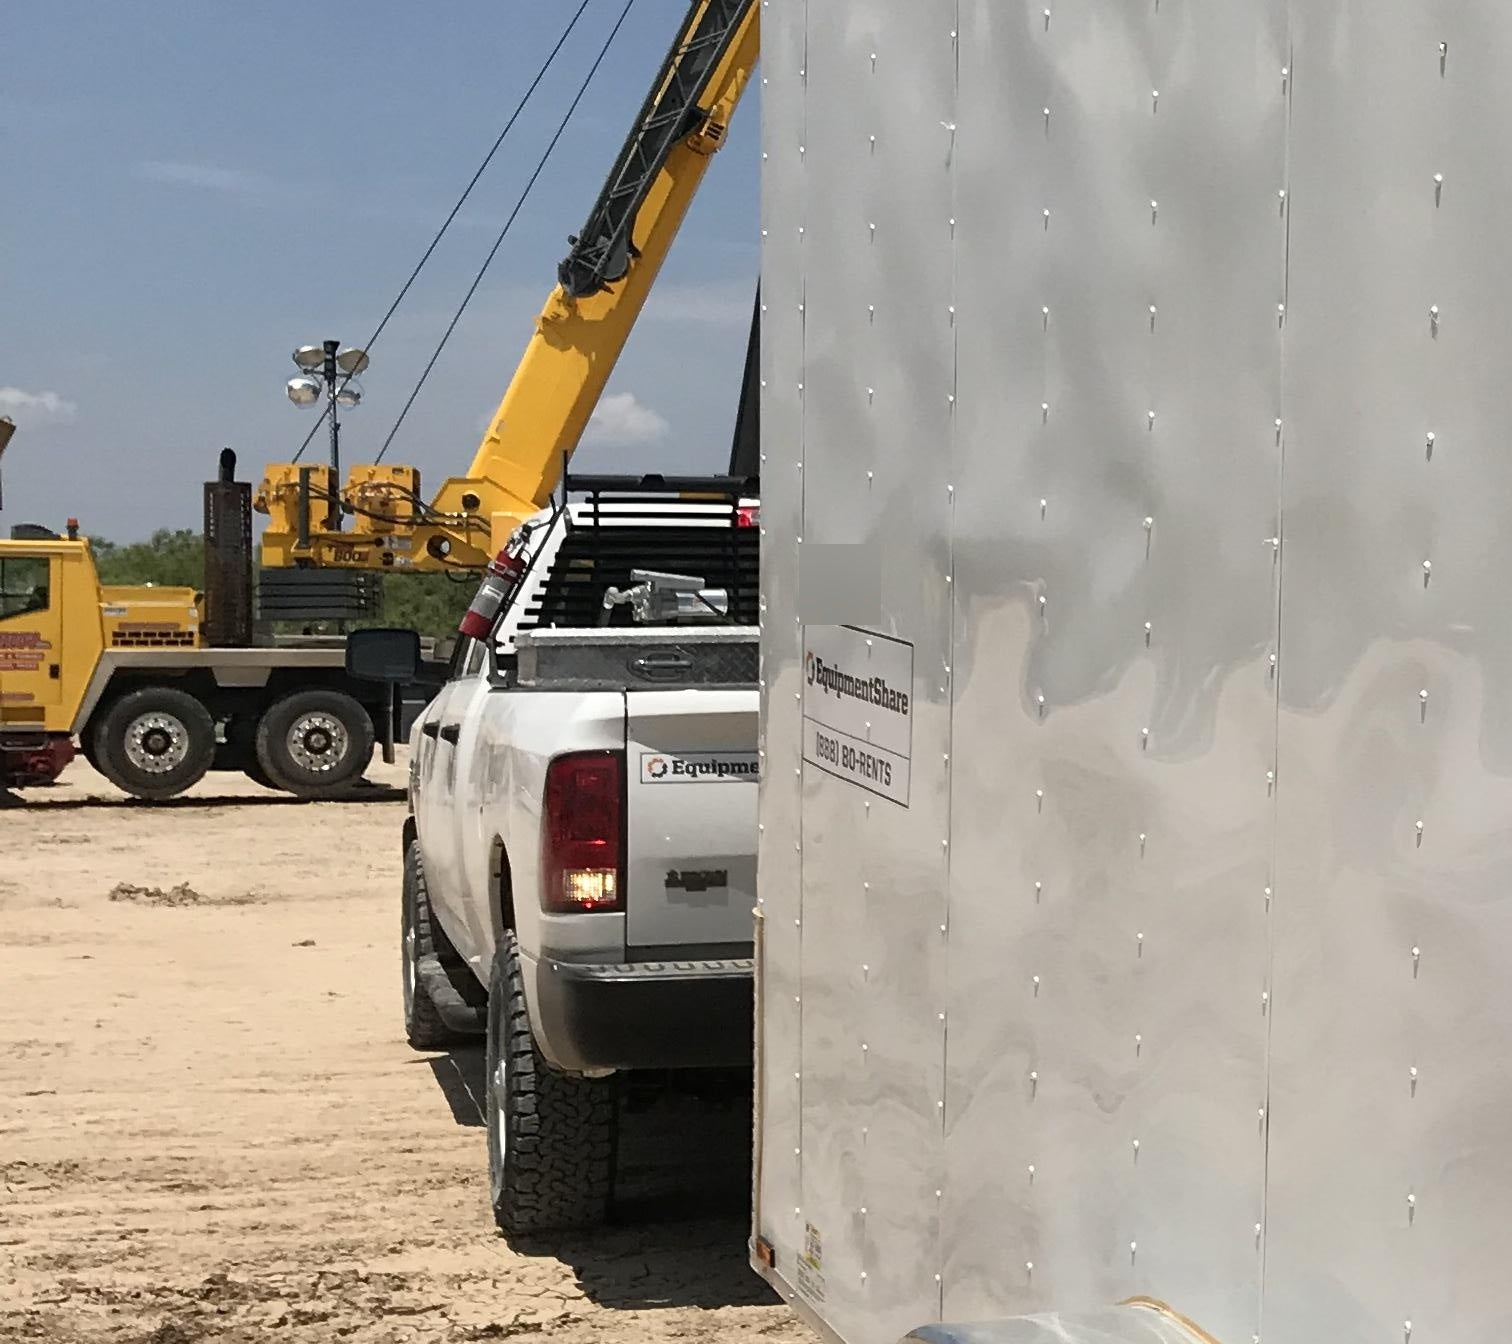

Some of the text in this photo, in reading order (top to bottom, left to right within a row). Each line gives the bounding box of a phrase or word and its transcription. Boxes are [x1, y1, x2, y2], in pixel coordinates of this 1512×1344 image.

[815, 657, 910, 716] EquipmentShare
[815, 731, 892, 787] (888) 80-RENTS
